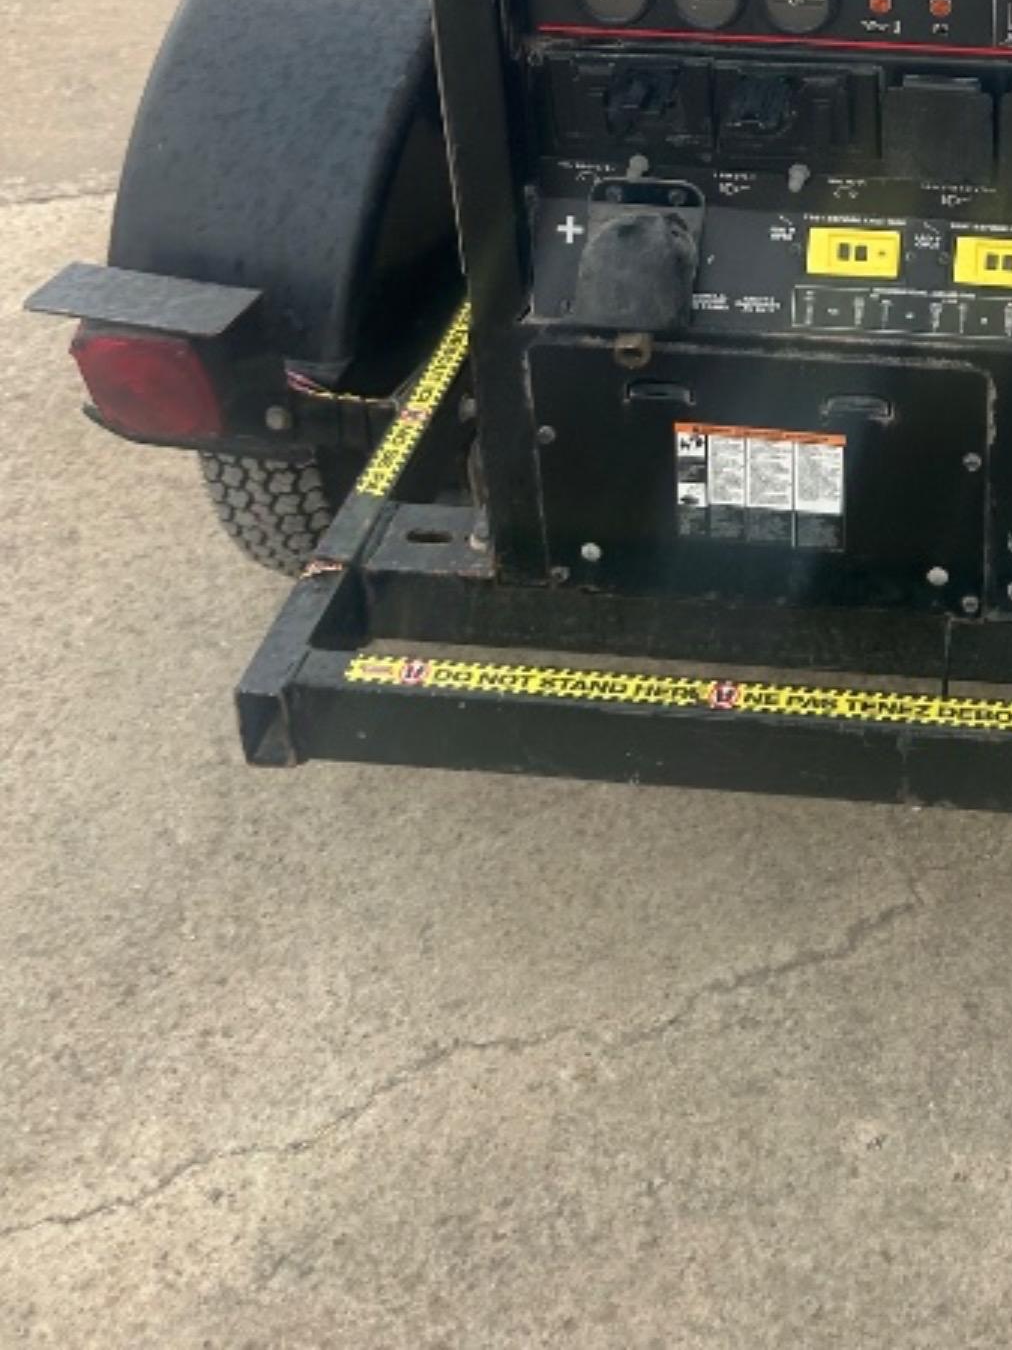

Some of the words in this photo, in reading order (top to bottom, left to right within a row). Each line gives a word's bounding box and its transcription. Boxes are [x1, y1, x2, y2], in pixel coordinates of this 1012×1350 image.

[433, 669, 472, 683] DO
[478, 671, 534, 687] NOT
[539, 677, 627, 695] STAND
[743, 692, 781, 707] NE
[785, 695, 838, 710] PAS
